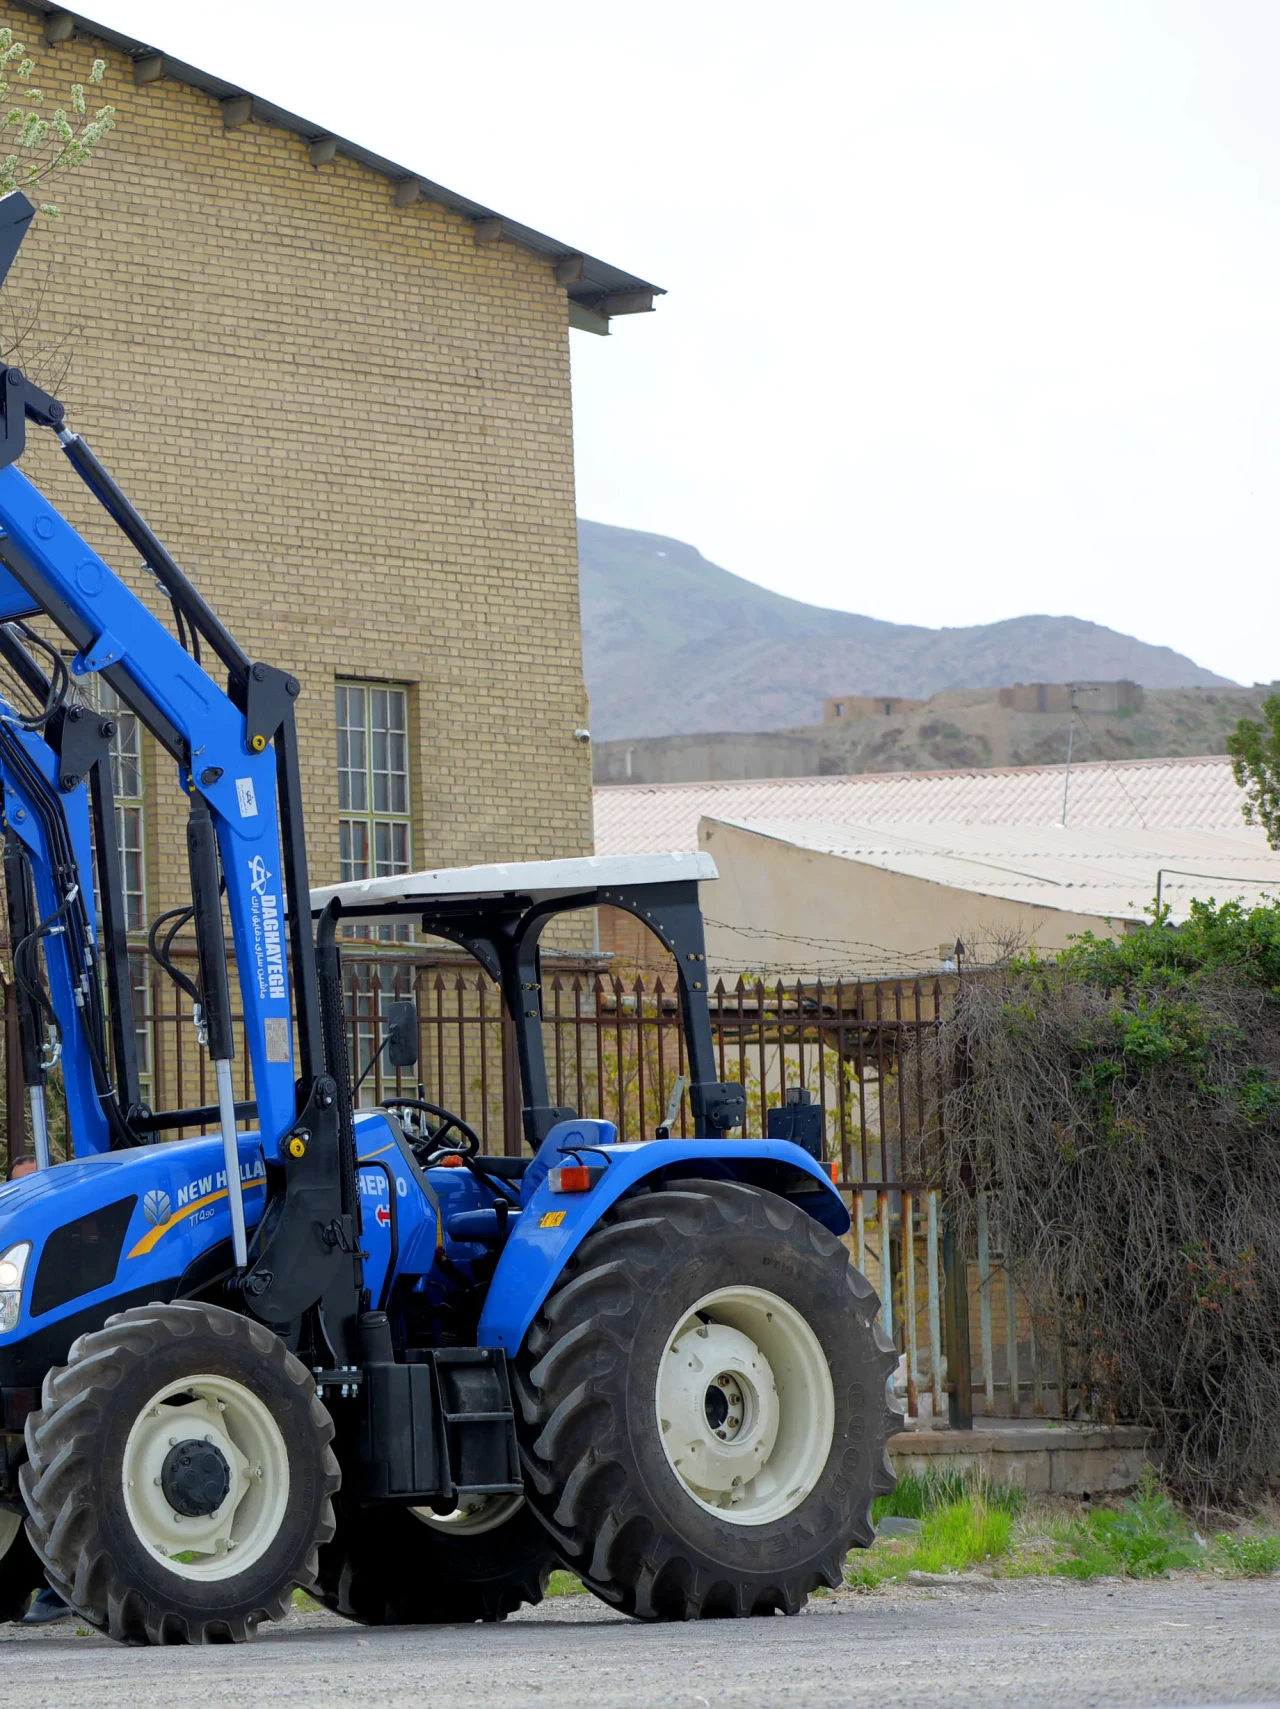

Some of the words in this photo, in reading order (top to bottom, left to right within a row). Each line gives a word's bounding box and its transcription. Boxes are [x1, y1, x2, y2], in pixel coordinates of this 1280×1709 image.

[260, 894, 286, 999] DAGHAYEGH
[177, 1174, 213, 1207] NEW
[216, 1158, 267, 1189] HLLA
